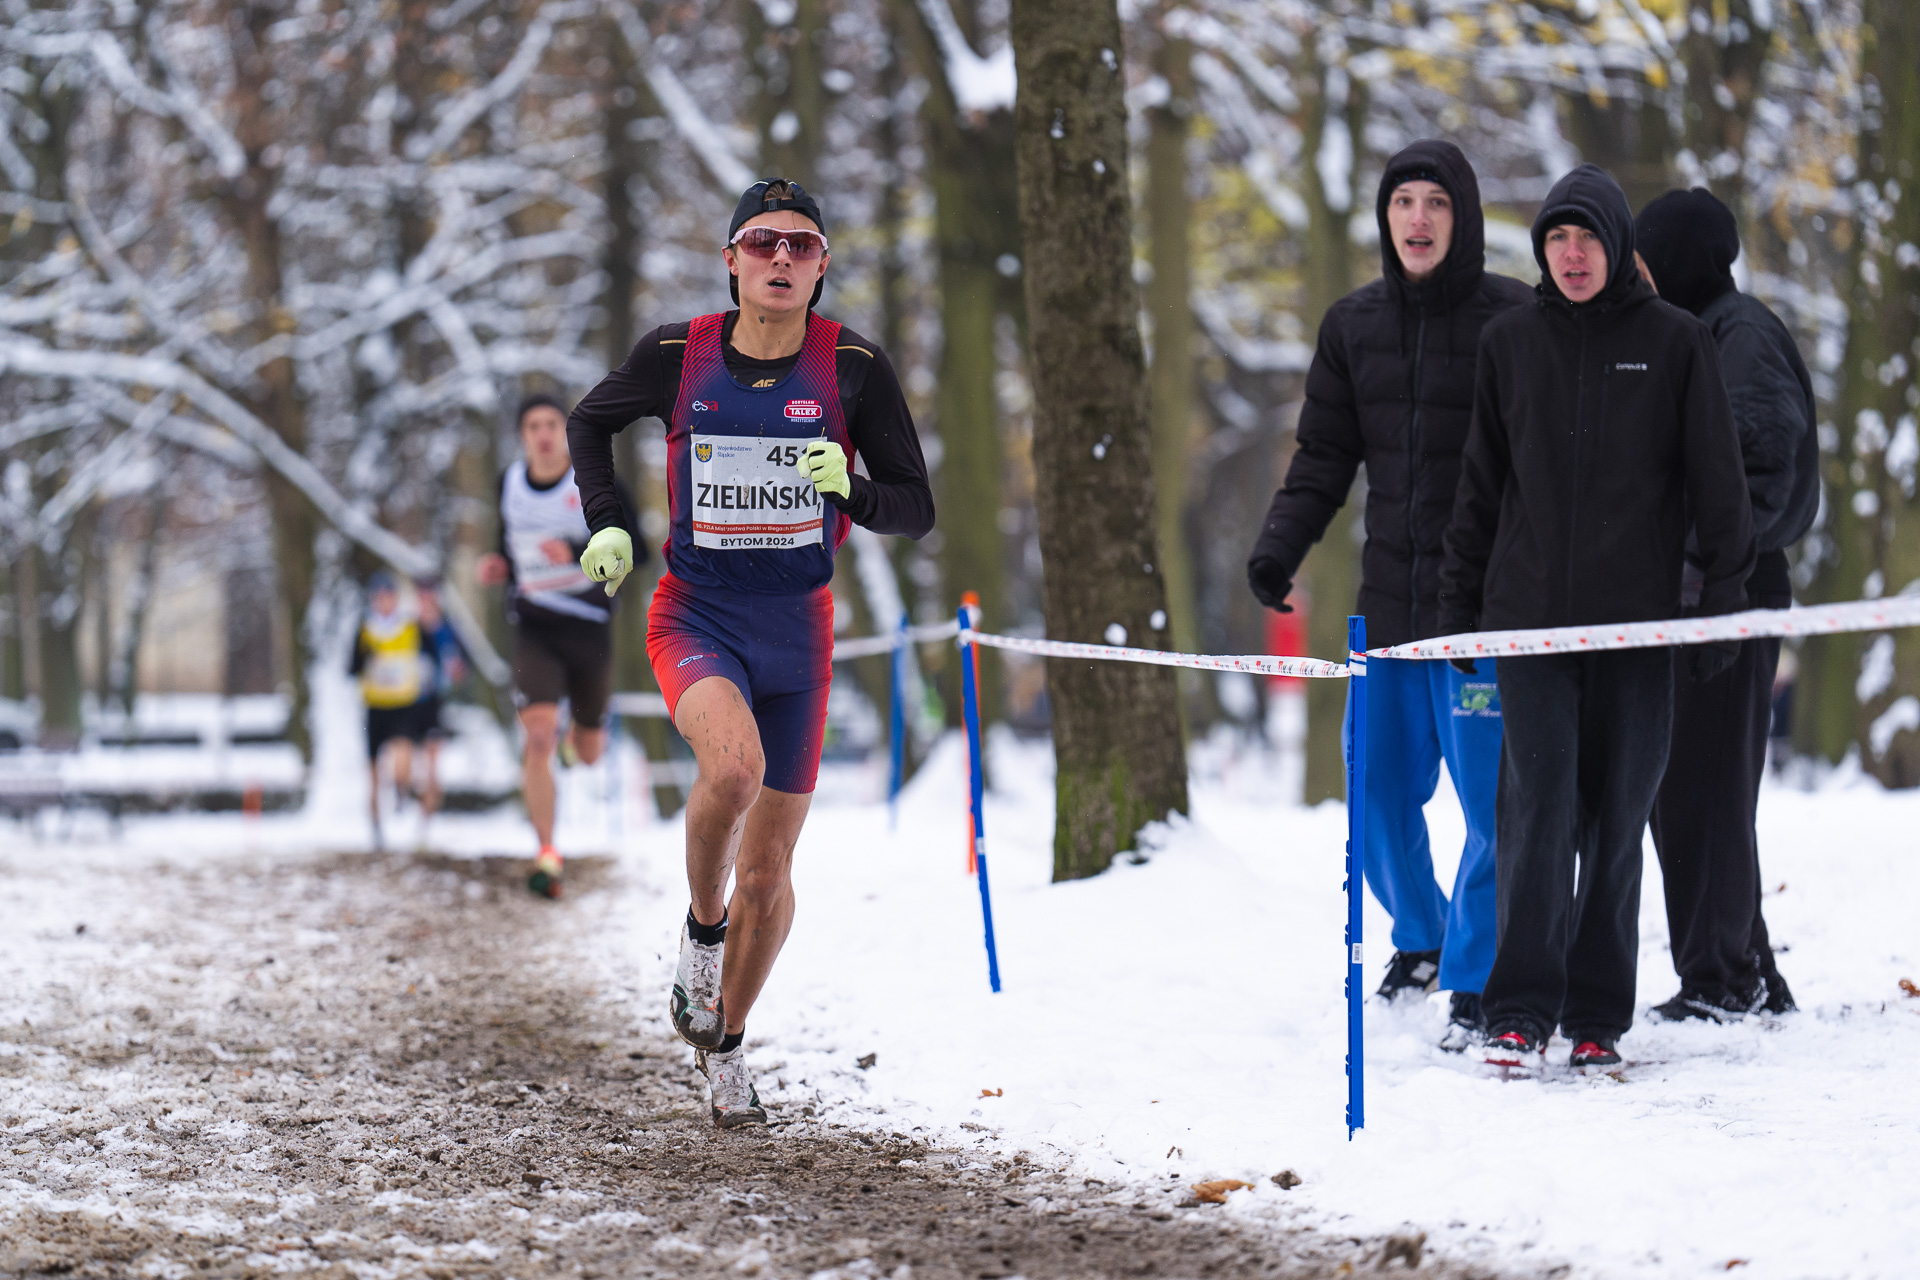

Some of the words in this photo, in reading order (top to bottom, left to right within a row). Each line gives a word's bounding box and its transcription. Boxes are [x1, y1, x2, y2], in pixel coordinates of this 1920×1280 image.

[788, 407, 818, 416] TALEX
[766, 445, 807, 467] 45
[697, 481, 818, 510] ZIELIŃSKI
[720, 538, 763, 547] BYTOM
[766, 537, 795, 546] 2024
